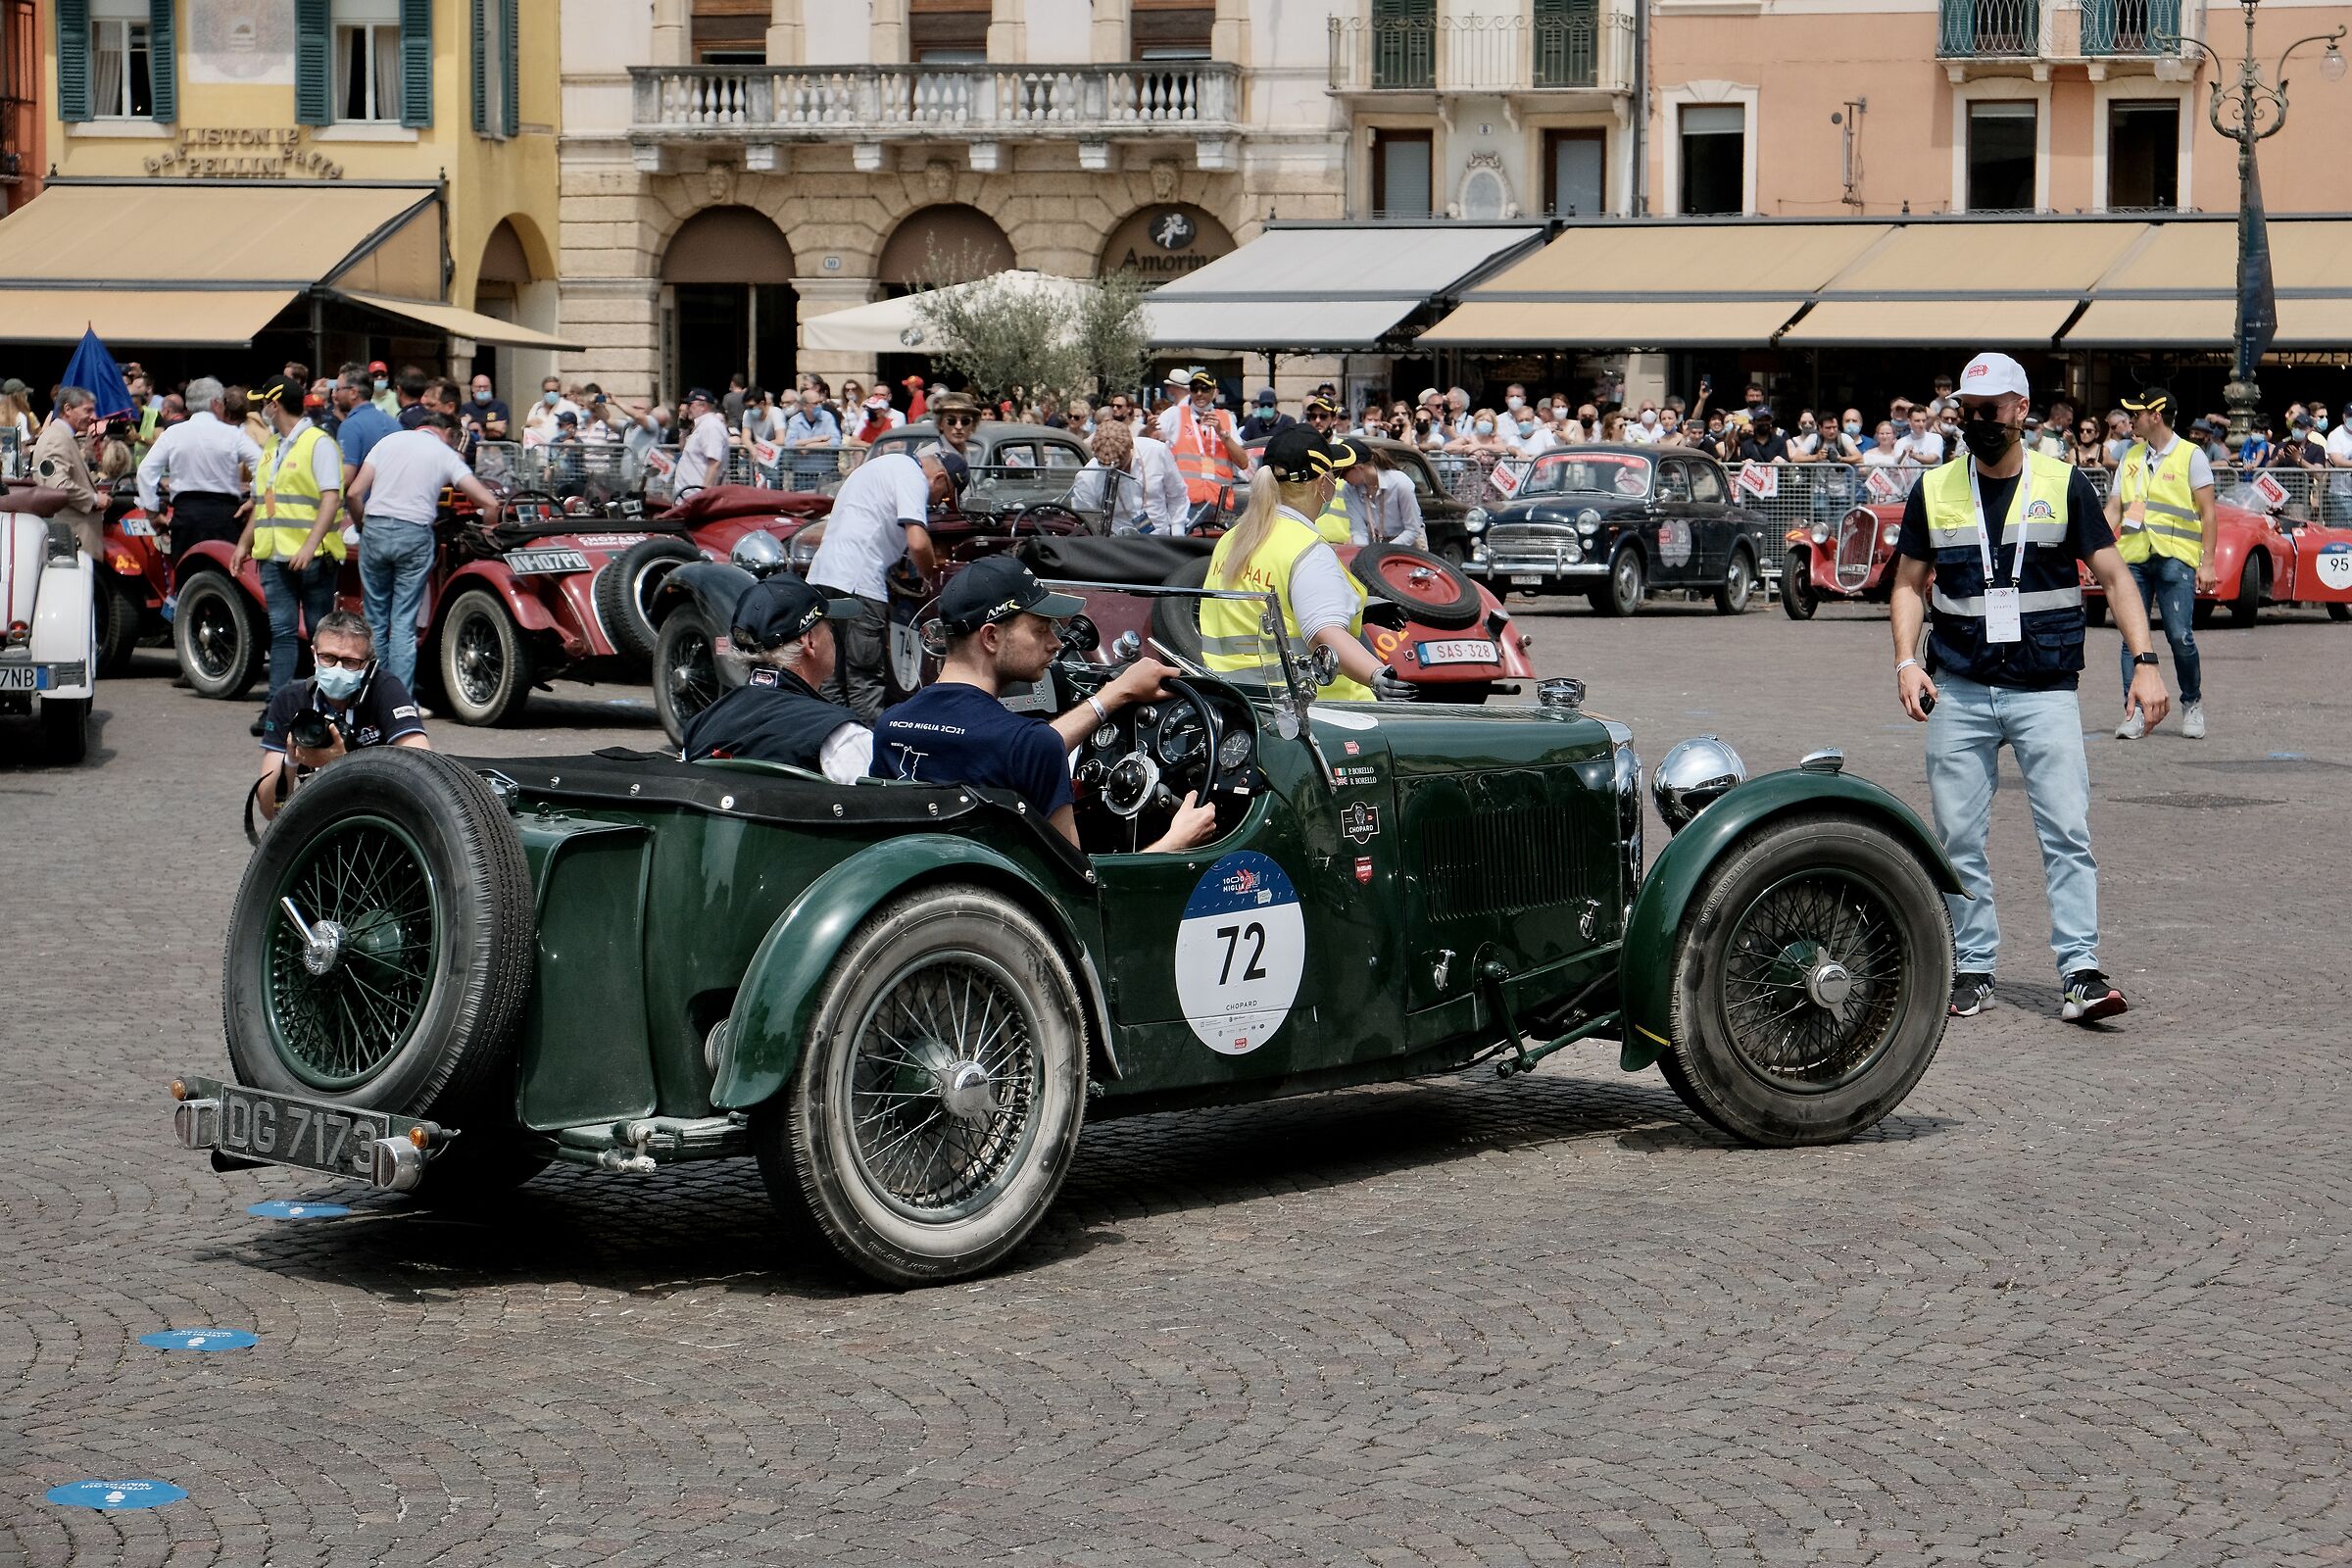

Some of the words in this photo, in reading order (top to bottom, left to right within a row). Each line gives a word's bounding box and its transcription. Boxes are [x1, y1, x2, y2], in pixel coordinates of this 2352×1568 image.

[181, 128, 270, 146] LISTON
[186, 158, 285, 175] PELLINI
[578, 535, 647, 545] CHOPARD
[2329, 557, 2349, 572] 95
[986, 599, 1021, 619] AMR
[914, 722, 939, 731] MIGLIA
[940, 725, 965, 735] 2021
[1348, 824, 1374, 834] CHOPARD
[1223, 876, 1245, 885] 1000
[1223, 883, 1245, 893] MIGLIA
[1217, 921, 1266, 985] 72
[1225, 1000, 1258, 1011] CHOPARD
[228, 1094, 276, 1154] DG
[287, 1105, 377, 1174] 7173
